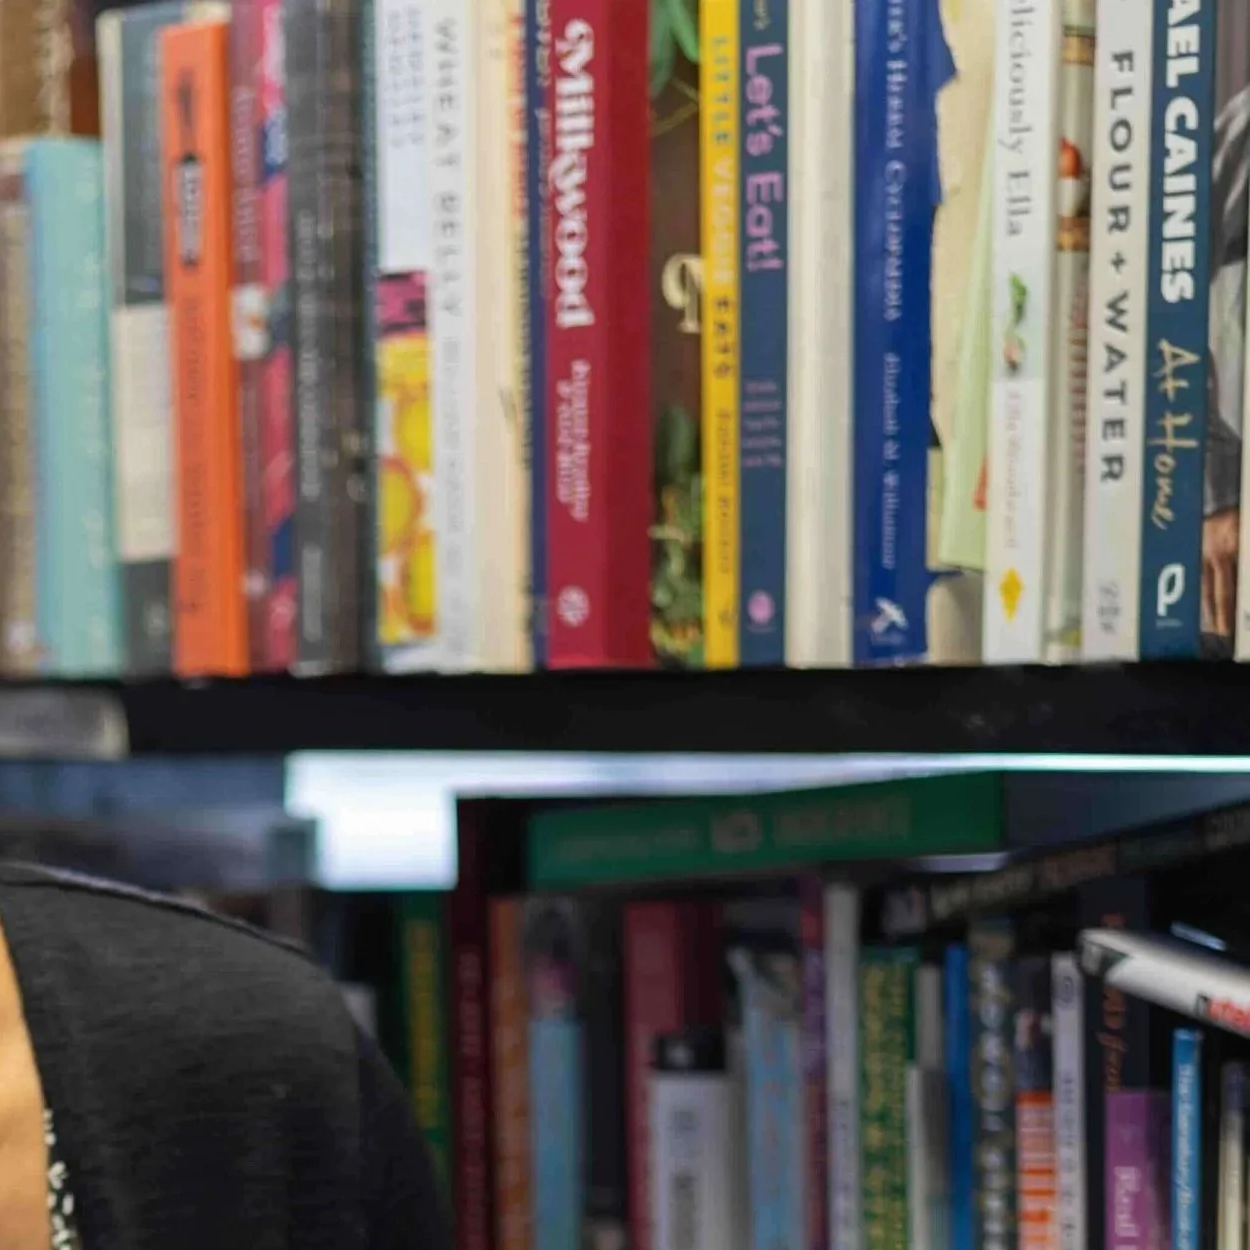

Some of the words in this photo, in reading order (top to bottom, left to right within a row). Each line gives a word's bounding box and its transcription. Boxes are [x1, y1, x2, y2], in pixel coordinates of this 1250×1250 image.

[711, 35, 734, 147] LITTLE
[746, 43, 784, 156] Let's
[1106, 49, 1136, 235] FLOUR
[550, 18, 596, 329] Milkwood
[746, 170, 784, 272] Eat!
[1005, 169, 1032, 238] Ella
[1160, 95, 1199, 304] CAINES
[1100, 290, 1131, 485] WATER
[1155, 338, 1201, 402] At
[1148, 410, 1201, 530] Home
